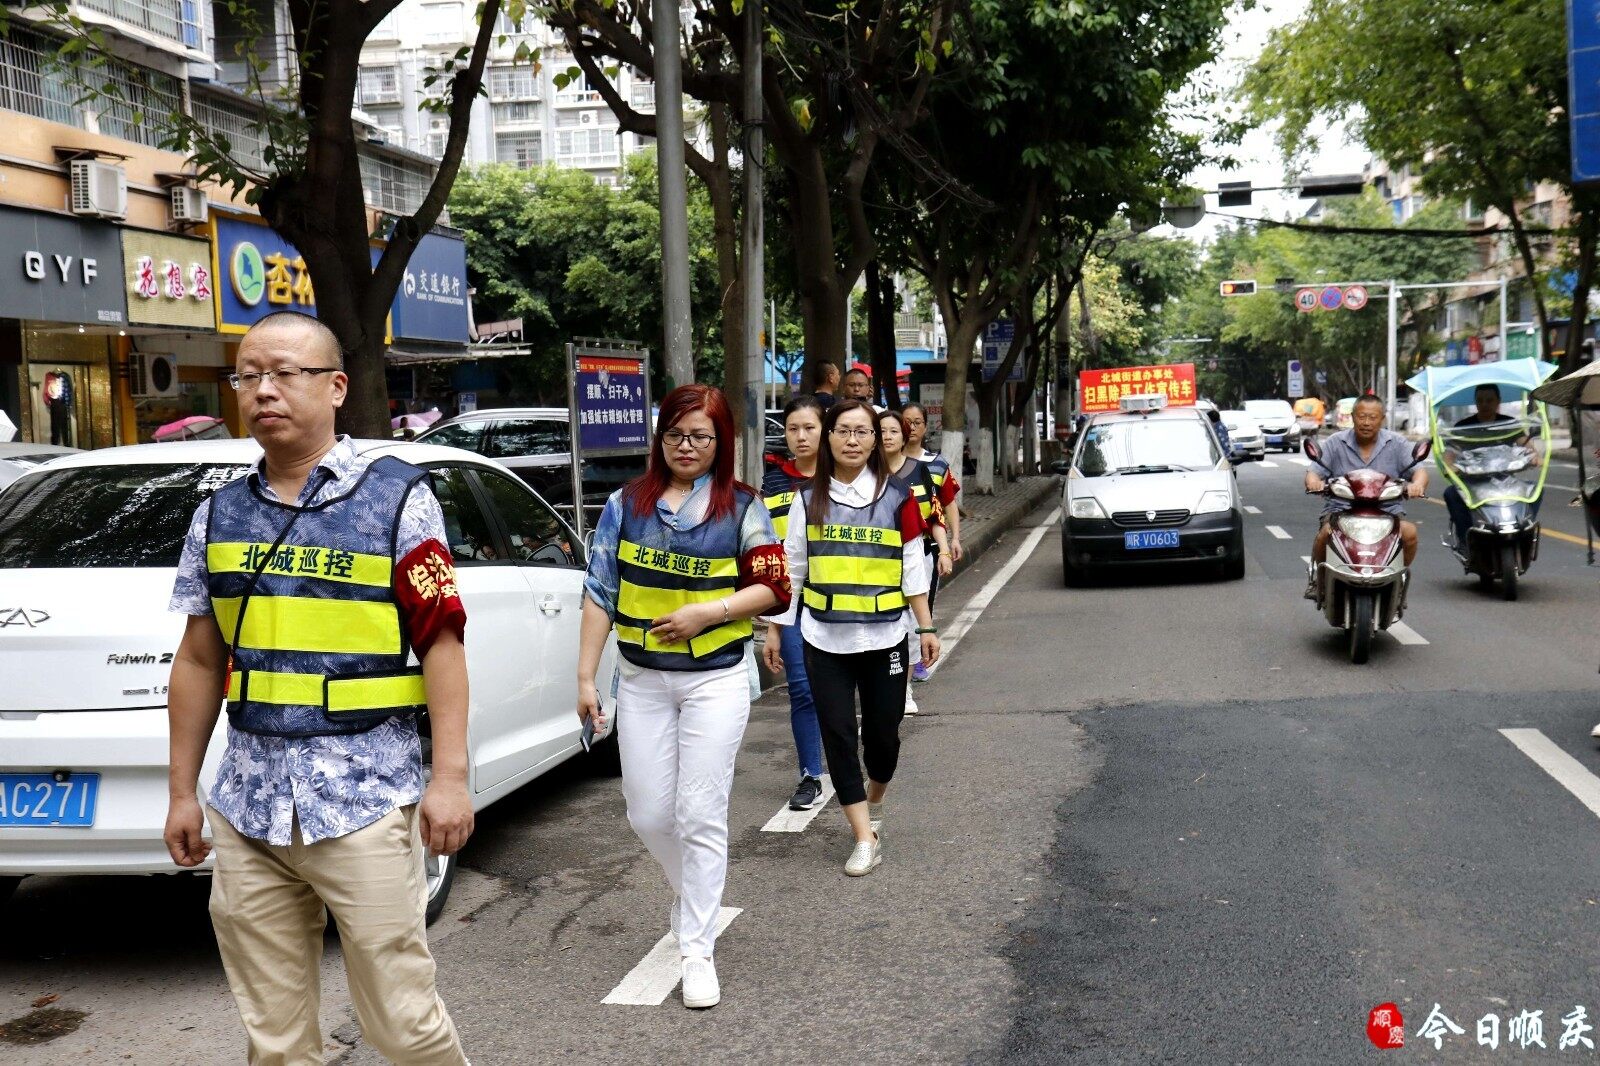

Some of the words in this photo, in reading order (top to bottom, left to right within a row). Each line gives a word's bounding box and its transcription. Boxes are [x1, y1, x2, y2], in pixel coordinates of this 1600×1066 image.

[24, 250, 98, 285] QYF
[1300, 293, 1316, 306] 40
[1101, 369, 1174, 384] 北城街道办事处
[1084, 379, 1193, 404] 扫黑除恶工作宣传车
[580, 408, 644, 425] 加强城市精细化管理
[824, 525, 883, 543] 北城巡控
[239, 544, 356, 579] 北城巡控
[633, 546, 712, 577] 北城巡控
[159, 652, 174, 664] 2
